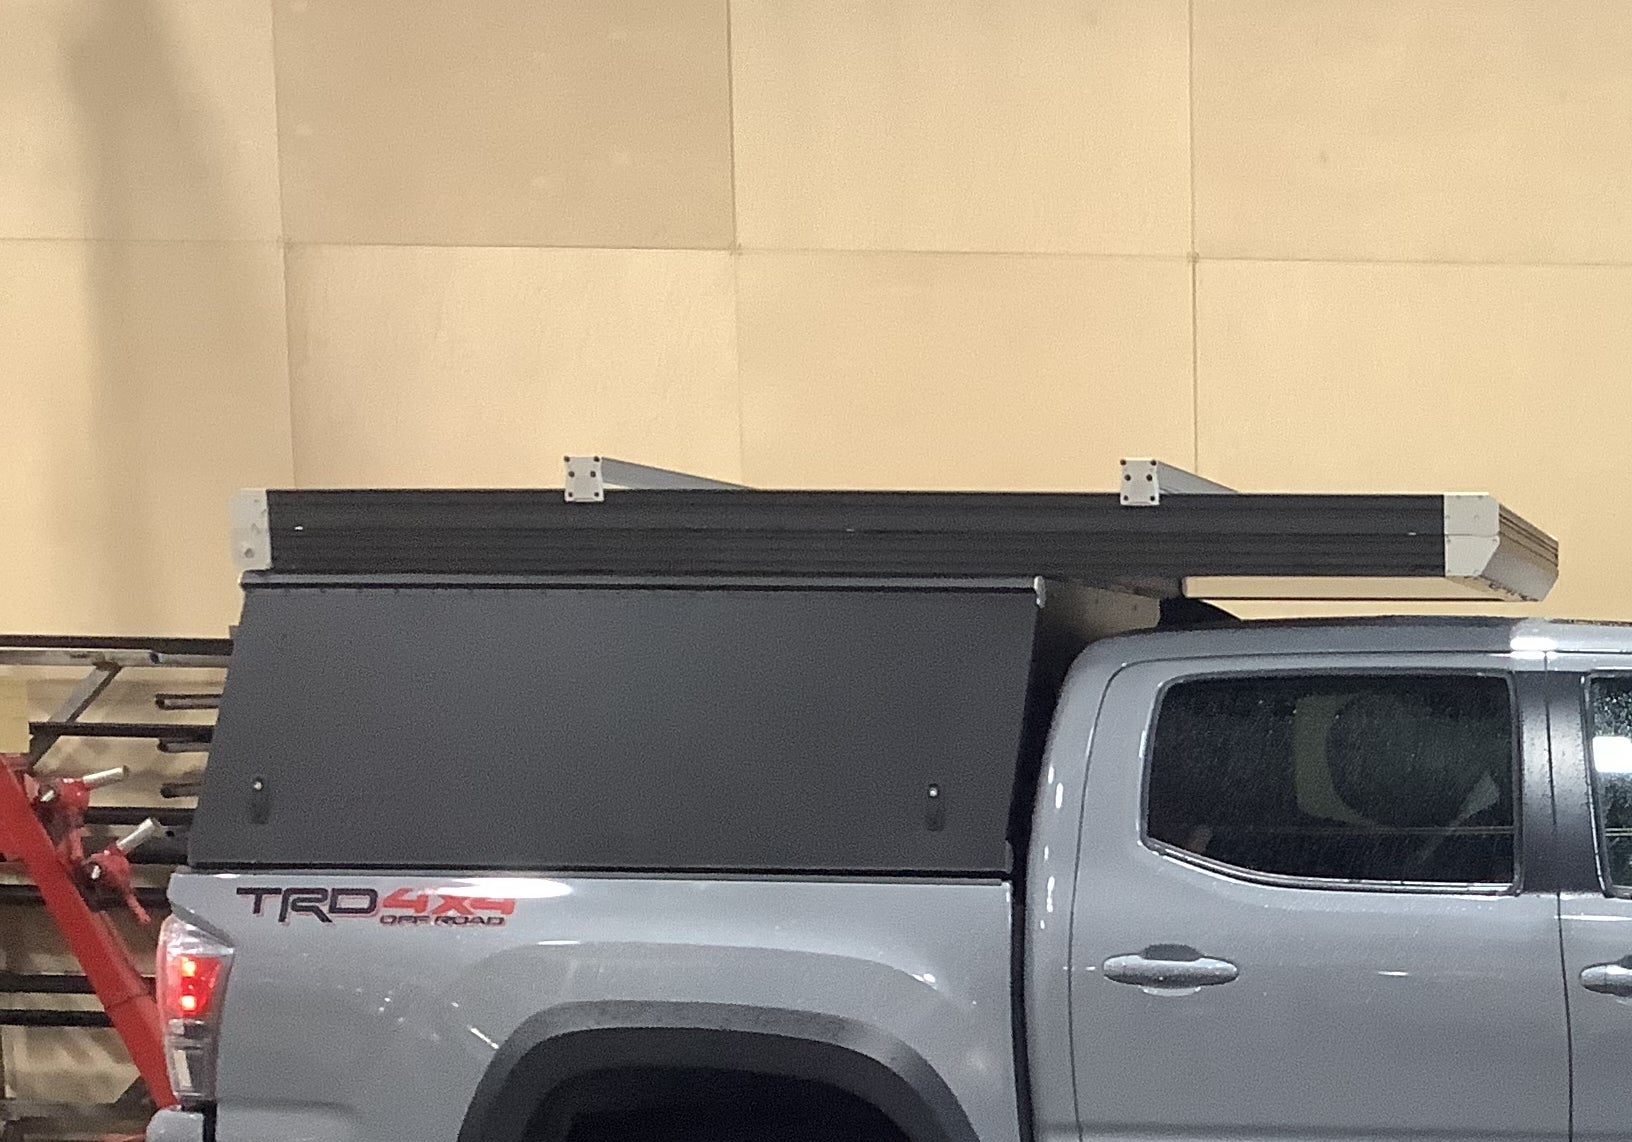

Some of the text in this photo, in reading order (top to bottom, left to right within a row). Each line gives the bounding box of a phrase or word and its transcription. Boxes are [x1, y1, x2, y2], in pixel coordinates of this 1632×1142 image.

[236, 887, 377, 923] TRD
[380, 914, 506, 926] OFF ROAD
